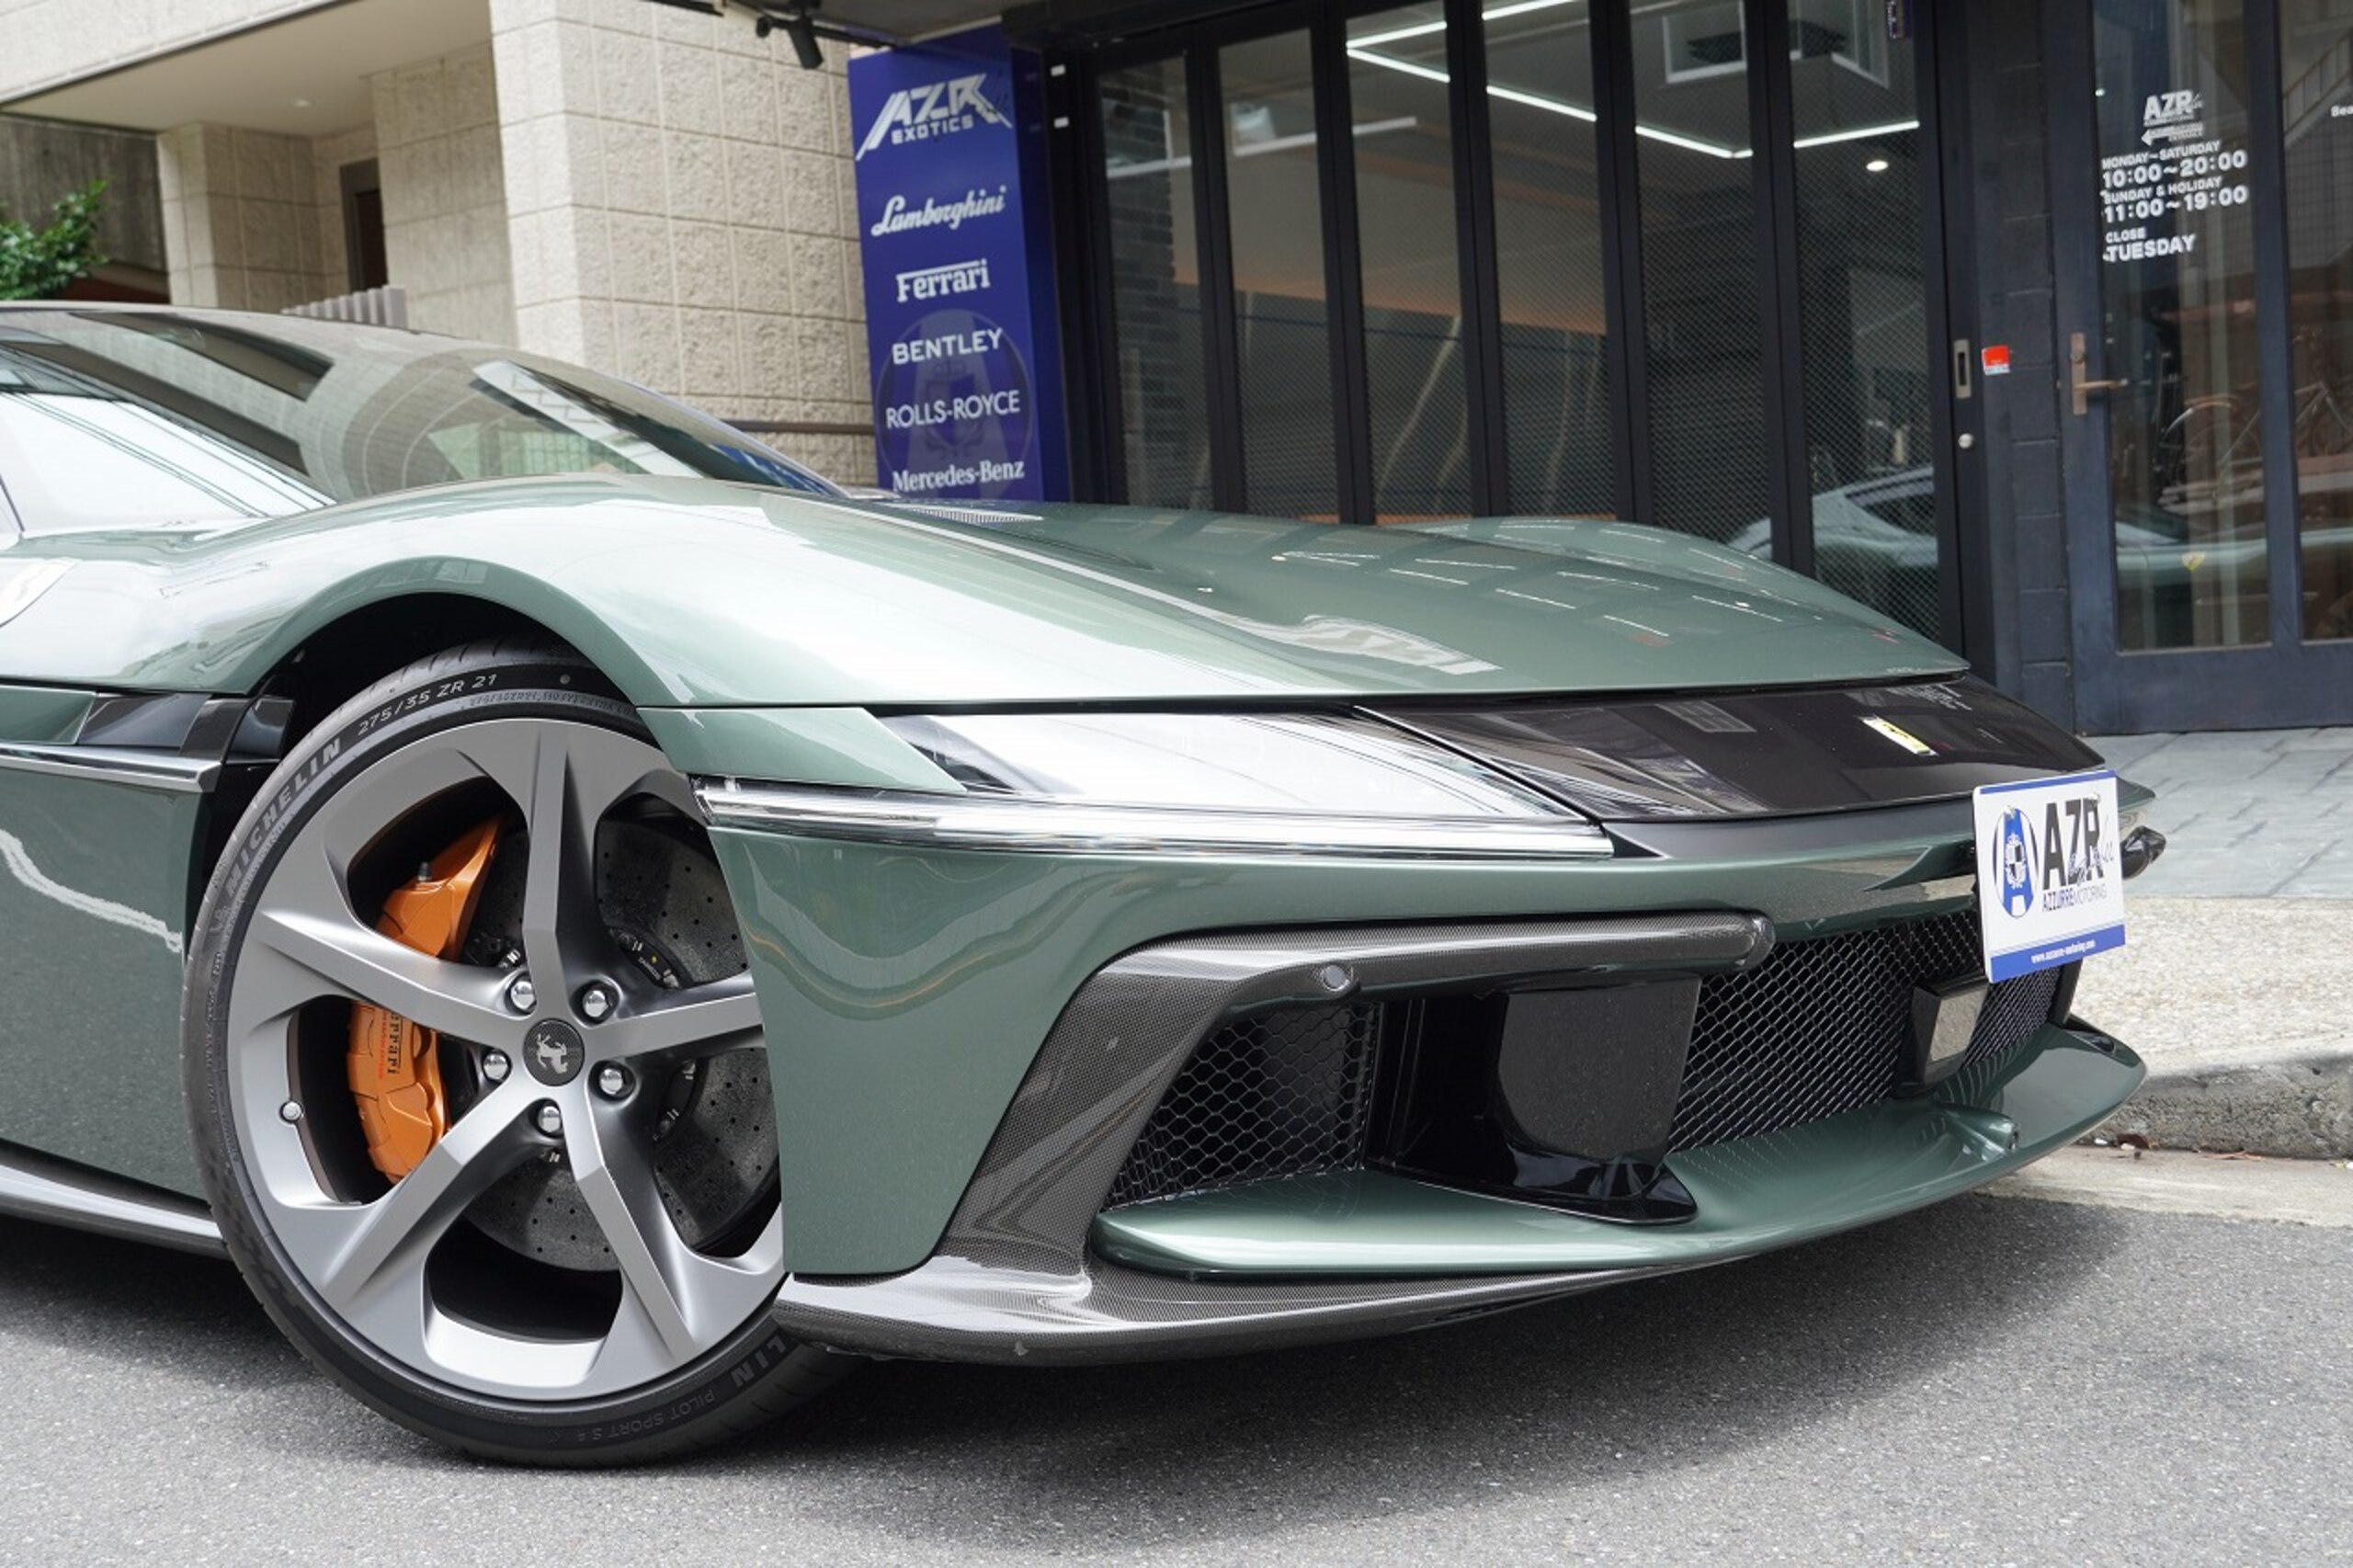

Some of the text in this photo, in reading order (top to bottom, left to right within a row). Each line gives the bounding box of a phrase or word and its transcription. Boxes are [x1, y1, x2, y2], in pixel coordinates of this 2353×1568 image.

[2143, 89, 2193, 120] AZR
[891, 114, 973, 145] EXOTICS
[2104, 176, 2222, 204] SUNDAY & HOLIDAY
[870, 185, 1006, 237] Lamborghini
[2105, 227, 2146, 244] CLOSE
[2106, 233, 2196, 263] TUESDAY
[895, 258, 991, 302] Ferrari
[892, 327, 1003, 365] BENTLEY
[885, 390, 1020, 429] ROLLS-ROYCE
[892, 460, 1025, 493] Mercedes-Benz
[358, 674, 497, 736] 275/35 ZR 21
[226, 737, 342, 898] MICHELIN
[2042, 798, 2105, 890] AZR
[671, 1390, 715, 1419] PILOT
[608, 1413, 664, 1438] SPORT
